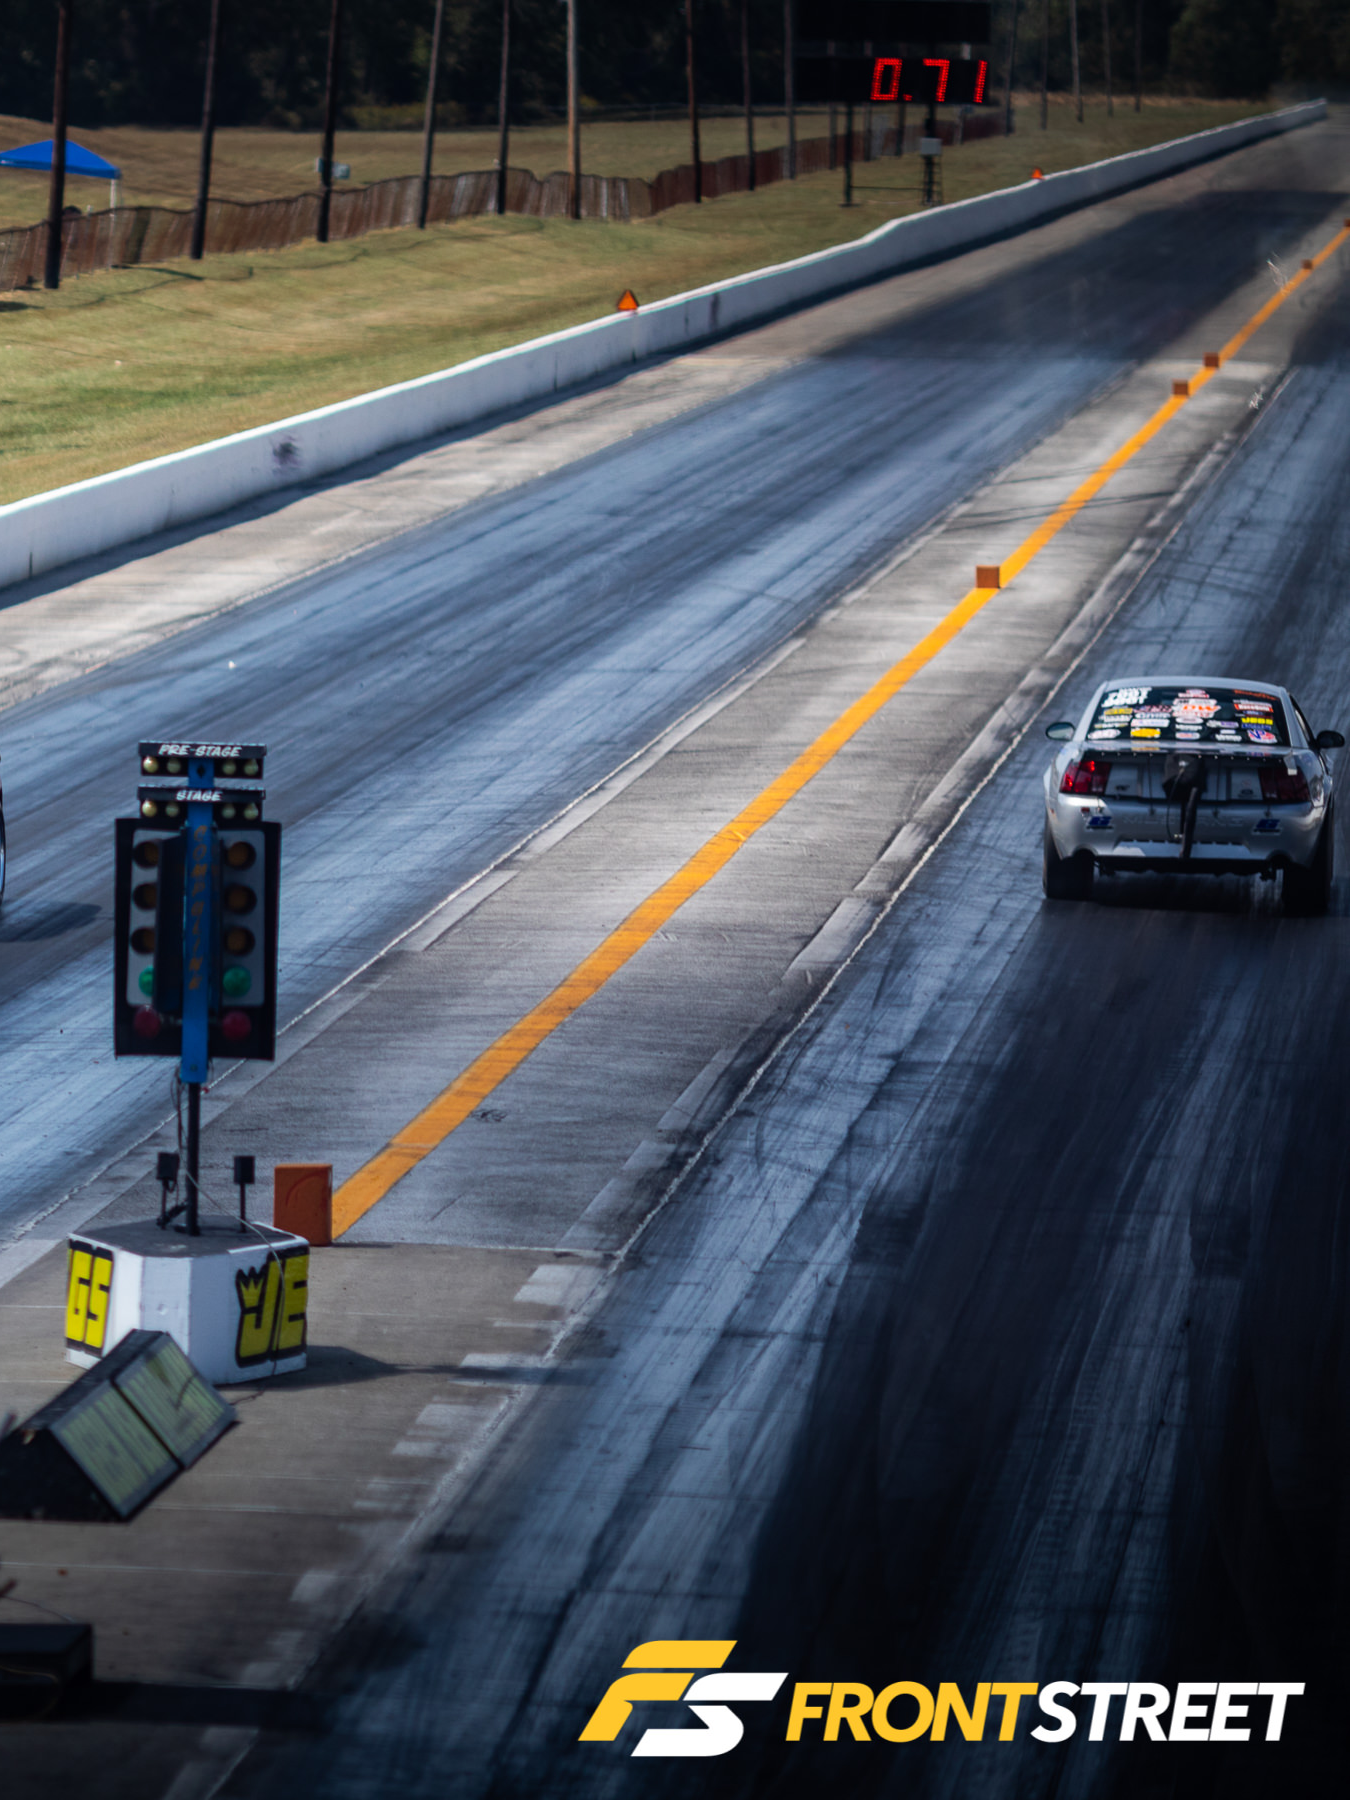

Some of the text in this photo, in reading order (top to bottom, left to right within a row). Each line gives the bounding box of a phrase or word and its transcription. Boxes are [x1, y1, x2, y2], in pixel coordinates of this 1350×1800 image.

[870, 58, 988, 103] 0.71
[158, 744, 242, 757] PRE-STAGE
[176, 789, 223, 802] STAGE
